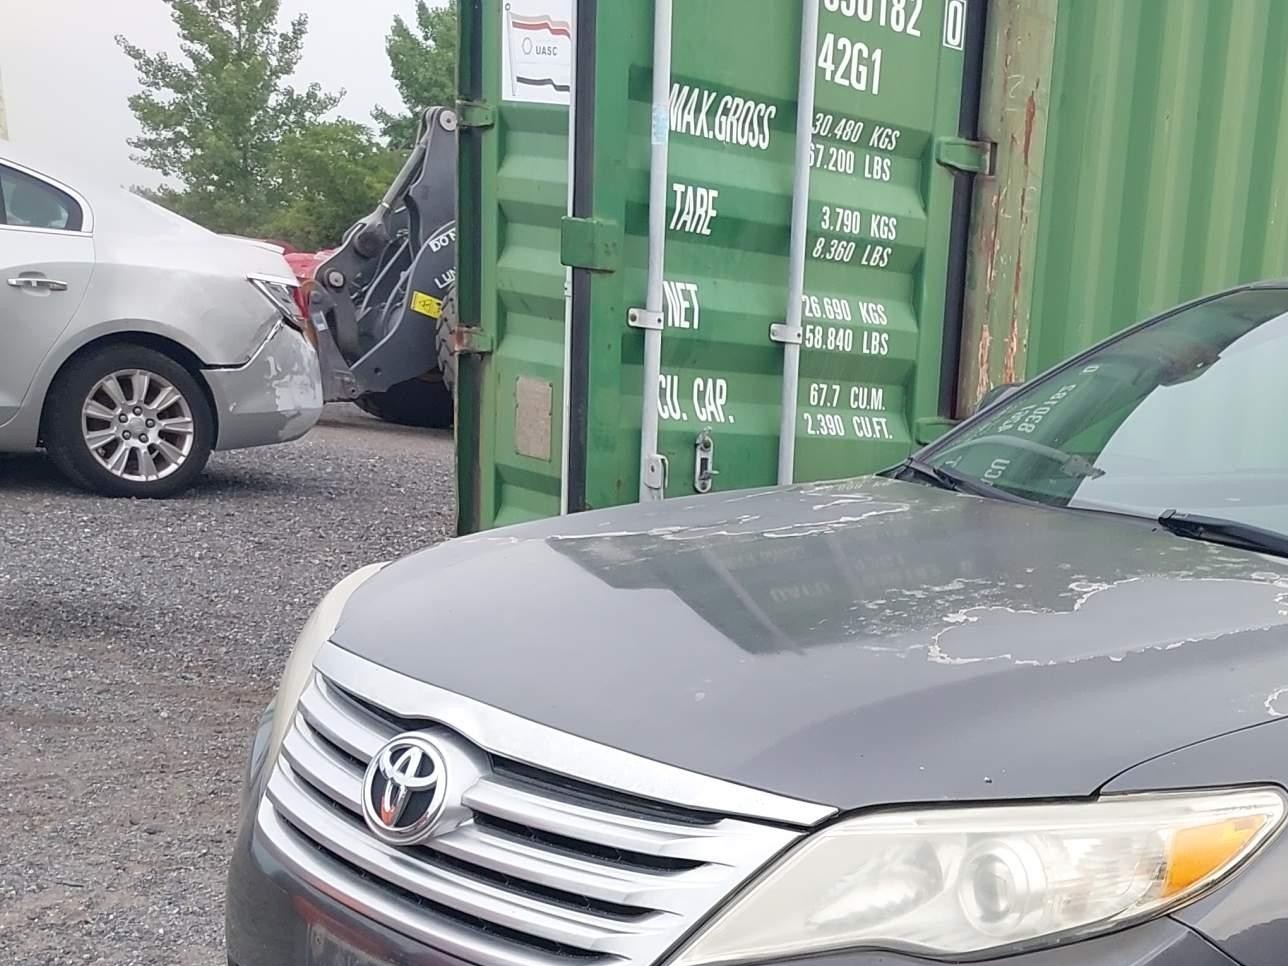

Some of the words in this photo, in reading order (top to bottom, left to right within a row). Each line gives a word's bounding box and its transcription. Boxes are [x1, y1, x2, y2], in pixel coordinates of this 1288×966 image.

[824, 0, 923, 37] 182
[535, 45, 558, 56] UASC
[817, 33, 882, 95] 42G1
[811, 112, 863, 144] 30.480
[869, 126, 900, 151] KGS
[864, 154, 891, 182] LBS
[669, 183, 719, 236] TARE
[821, 206, 861, 235] 3.790
[870, 214, 897, 241] KGS
[812, 237, 856, 263] 8.360
[861, 244, 893, 268] LBS
[663, 280, 700, 330] NET
[802, 295, 851, 321] 26.690
[858, 301, 888, 326] KGS
[804, 324, 853, 352] 58.840
[862, 331, 889, 356] LBS
[692, 377, 735, 424] CAP.
[809, 383, 841, 408] 67.7
[849, 386, 886, 411] CU.M.
[804, 413, 845, 437] 2.390
[852, 415, 893, 440] CU.FT.
